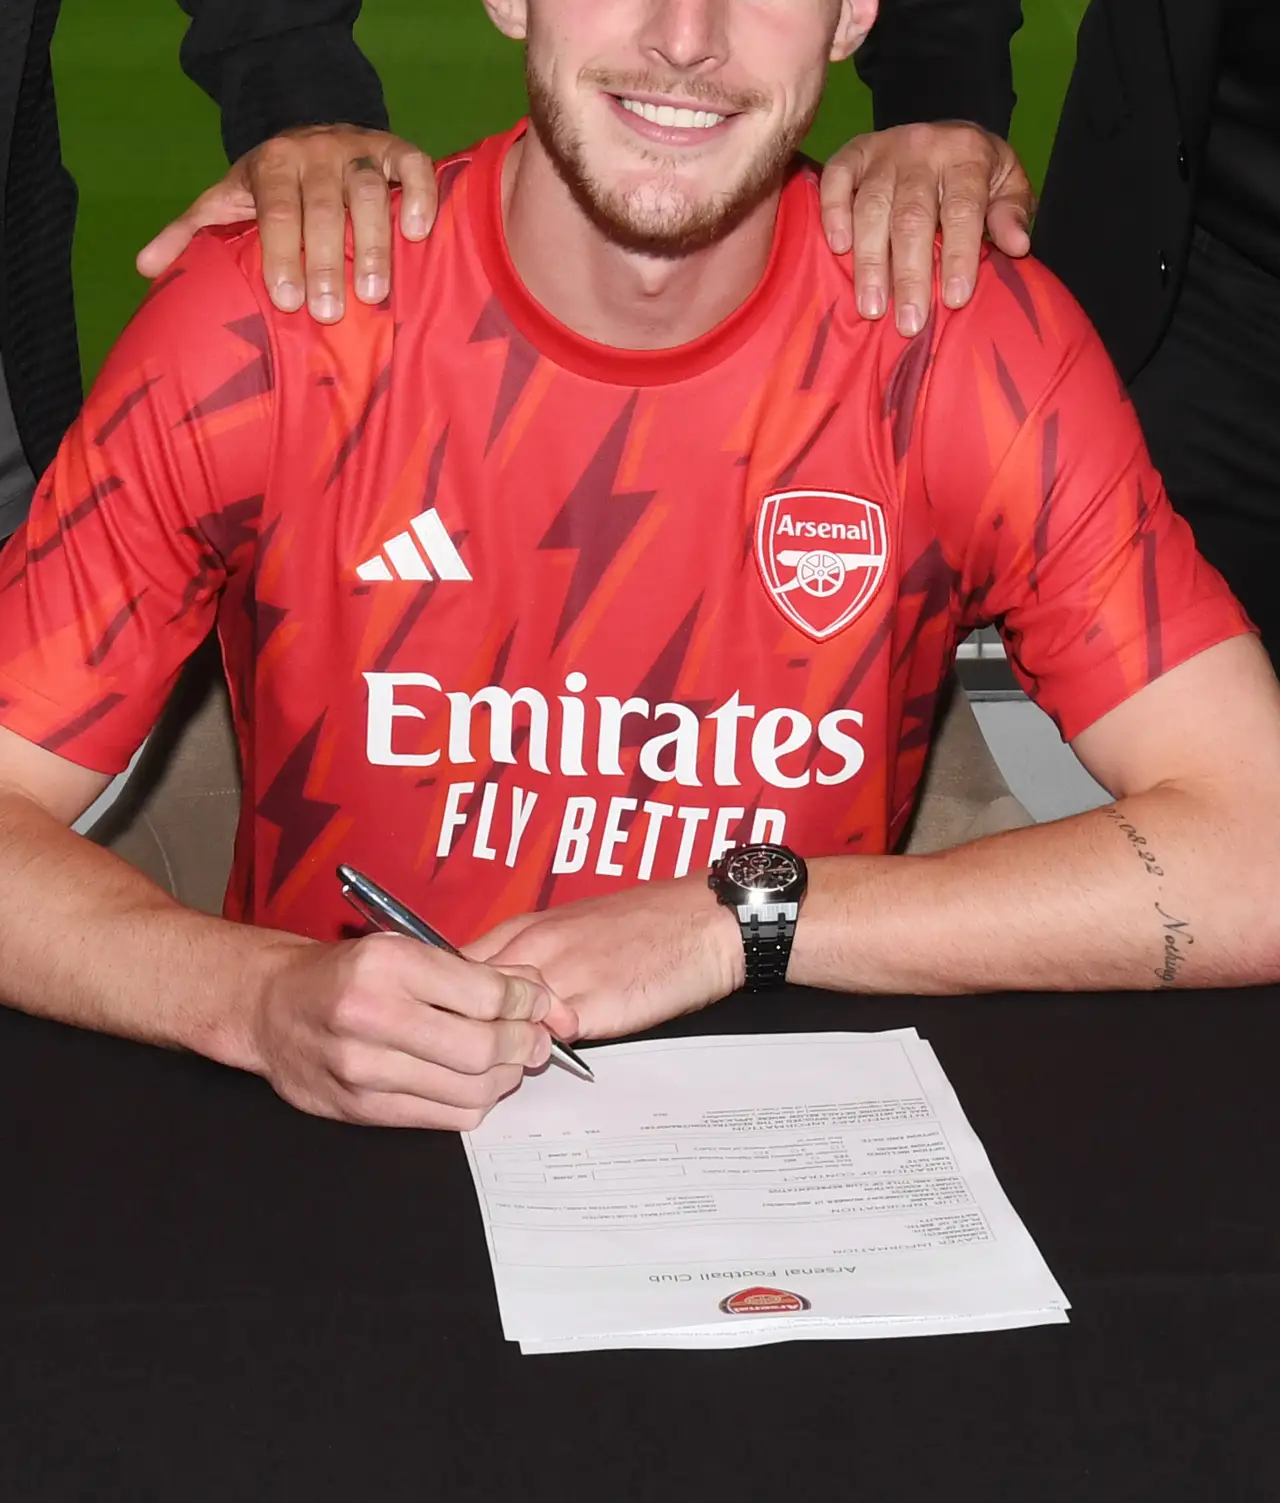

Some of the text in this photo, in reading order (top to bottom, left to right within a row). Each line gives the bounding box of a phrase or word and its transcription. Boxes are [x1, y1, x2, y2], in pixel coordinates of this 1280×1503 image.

[776, 513, 868, 541] Arsenal
[362, 671, 866, 789] Emirates
[436, 782, 539, 868] FLY
[1154, 901, 1195, 982] Nothing
[648, 1266, 857, 1283] Arsenal Football Club
[733, 1304, 799, 1313] Arsenal
